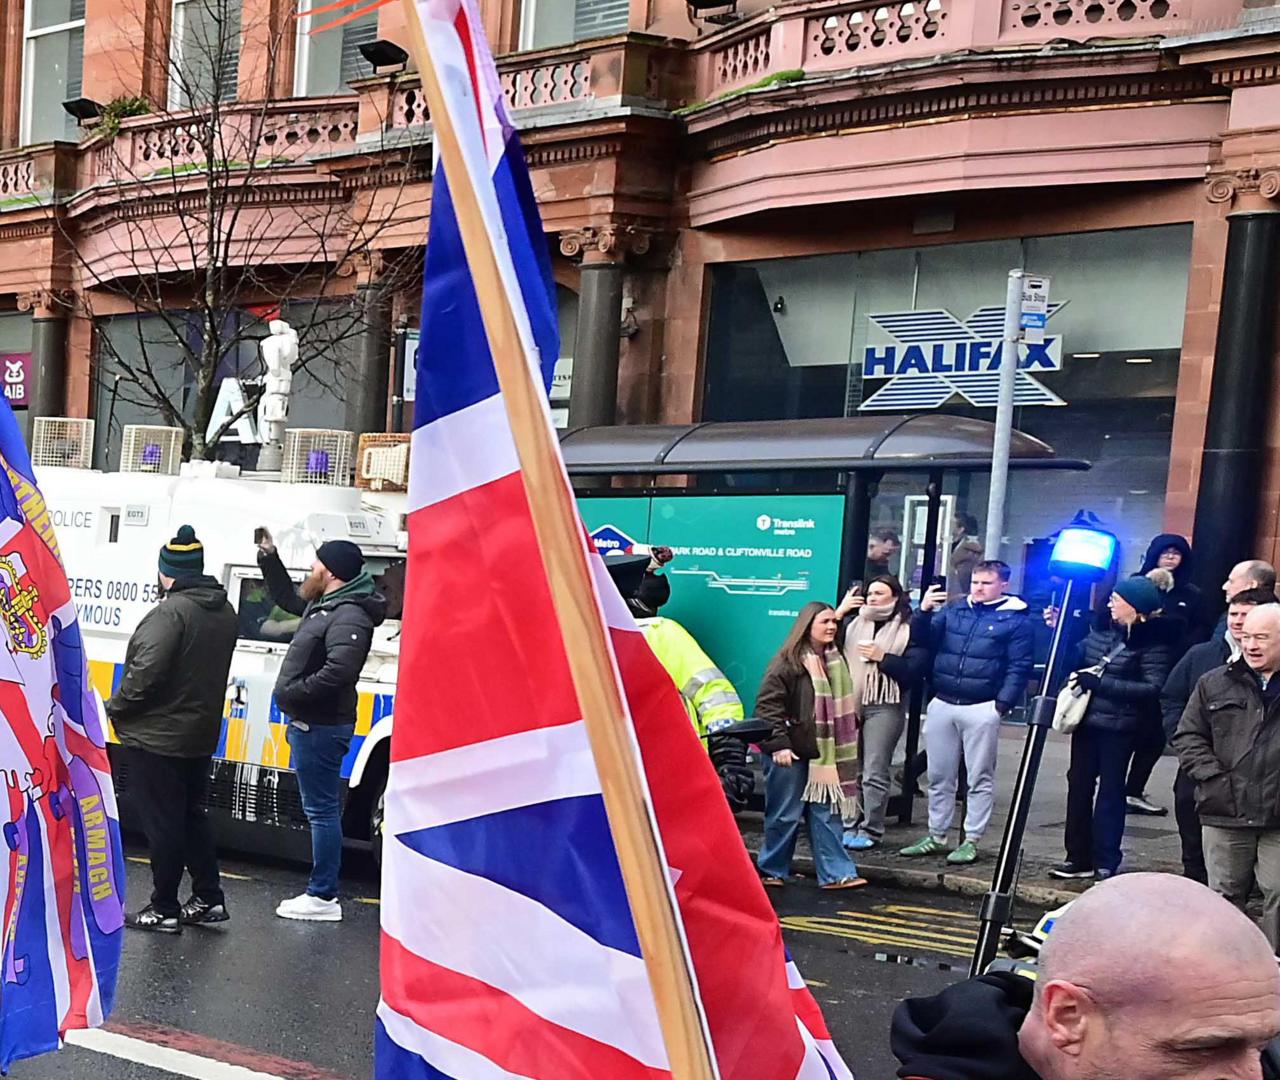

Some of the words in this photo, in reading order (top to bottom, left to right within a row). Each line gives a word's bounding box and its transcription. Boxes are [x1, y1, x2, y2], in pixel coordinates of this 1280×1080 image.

[1033, 292, 1046, 303] Stop
[4, 384, 25, 400] AIB
[772, 517, 815, 529] Translink
[594, 538, 620, 549] Metro
[692, 547, 717, 557] ROAD
[725, 548, 785, 558] CLIFTONVILLE
[786, 549, 813, 558] ROAD
[106, 580, 138, 602] 0800
[142, 583, 159, 604] 55
[79, 794, 113, 901] ARMAGH
